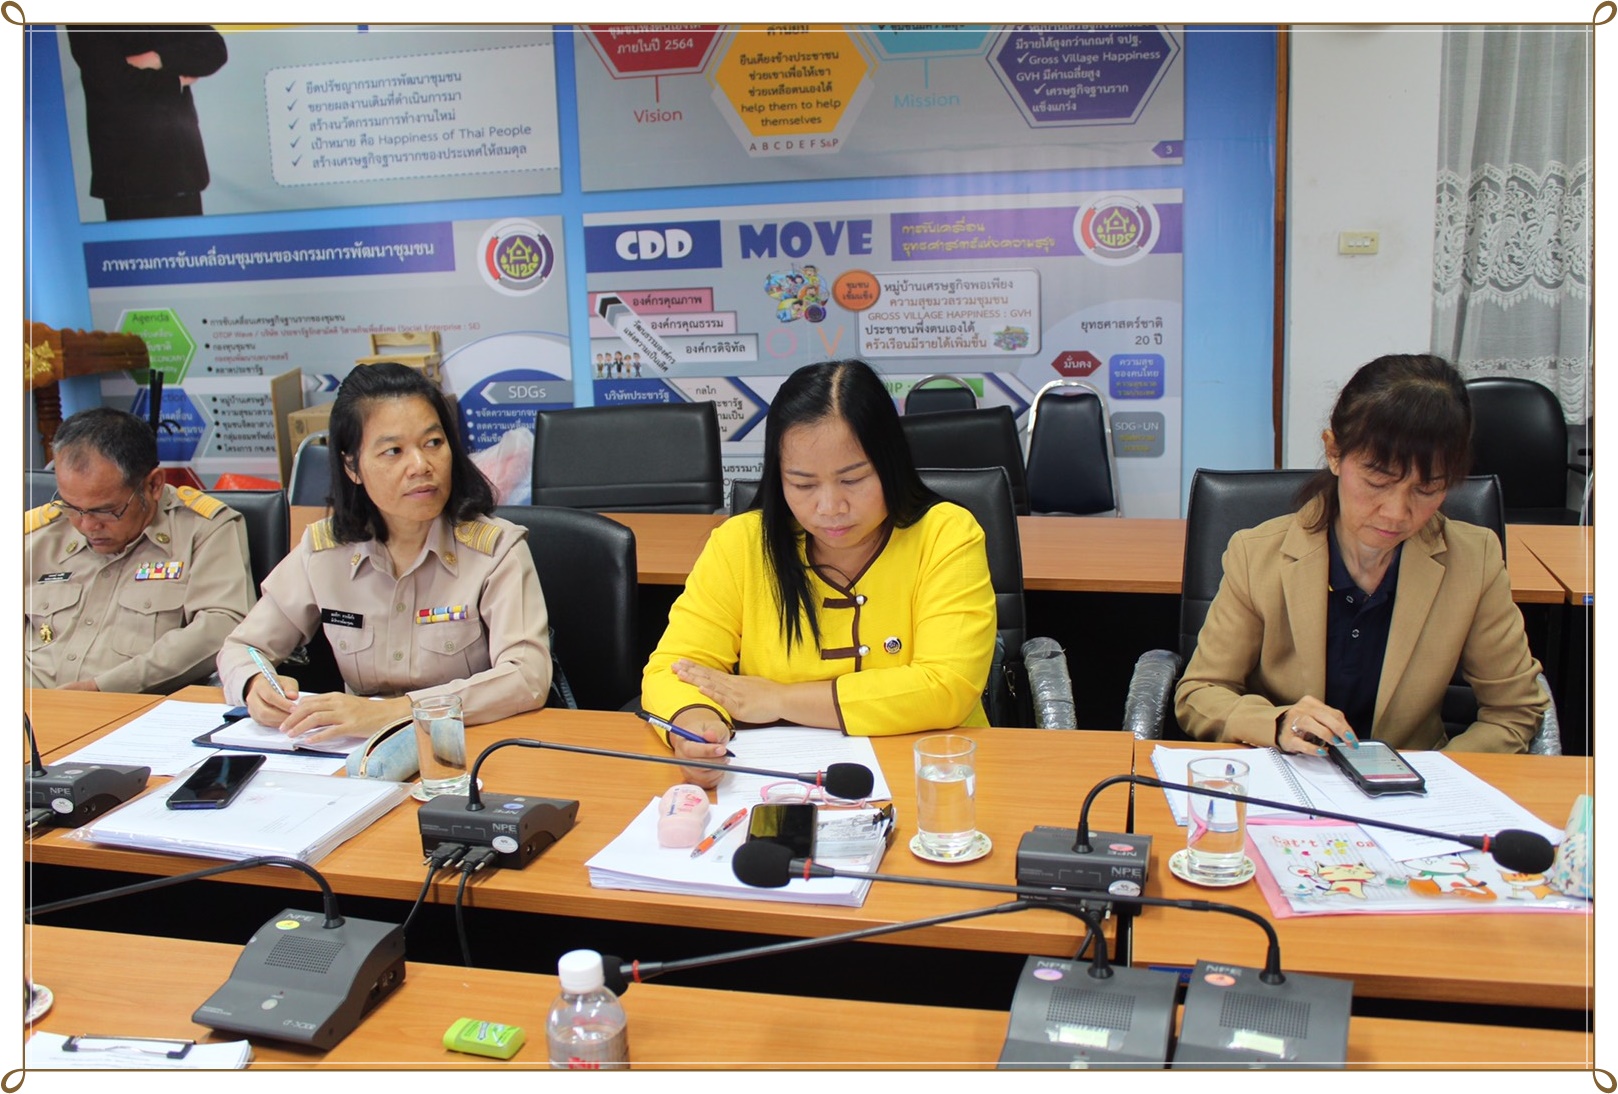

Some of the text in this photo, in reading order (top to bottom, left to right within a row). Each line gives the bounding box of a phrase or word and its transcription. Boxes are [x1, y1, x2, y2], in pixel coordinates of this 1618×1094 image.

[617, 38, 694, 54] ภายในปี 2564
[1029, 51, 1160, 65] Gross Village Happiness
[1016, 72, 1040, 81] GVH
[741, 98, 841, 113] help them to help
[894, 93, 960, 108] Mission
[634, 109, 682, 123] Vision
[761, 115, 822, 126] themselves
[311, 125, 531, 150] เป้าหมาย คือ Happiness of Thai People
[749, 143, 757, 151] A
[762, 142, 769, 151] B
[774, 141, 780, 150] C
[786, 141, 793, 149] D
[799, 140, 805, 149] E
[810, 140, 816, 148] F
[1166, 145, 1172, 154] 3
[615, 229, 692, 260] CDD
[739, 220, 872, 259] MOVE
[101, 241, 434, 272] ภาพรวมการขับเคลื่อนชุมชนของกรมการพัฒนาชุมชน
[884, 277, 1013, 295] หมู่บ้านเศรษฐกิจพอเพียง
[633, 294, 702, 308] องค์กรคุณภาพ
[890, 295, 1008, 309] ความสุขมวลรวมชุมชน
[868, 311, 900, 321] GROSS
[904, 311, 943, 321] VILLAGE
[946, 310, 1000, 319] HAPPINESS
[1010, 309, 1032, 318] GVH
[651, 317, 723, 331] องค์กรคุณธรรม
[1081, 315, 1163, 332] ยุทธศาสตร์ชาติ
[1135, 333, 1163, 345] 20 ปี
[685, 341, 745, 353] องค์กรดิจิทัล
[1064, 355, 1092, 369] มั่นคง
[508, 386, 546, 399] SDGs
[604, 388, 669, 402] บริษัทประชารัฐ
[696, 385, 716, 396] กลไก
[49, 787, 71, 795] NPE
[492, 823, 517, 833] NPE
[1111, 866, 1141, 876] NPE
[286, 913, 315, 922] NPE
